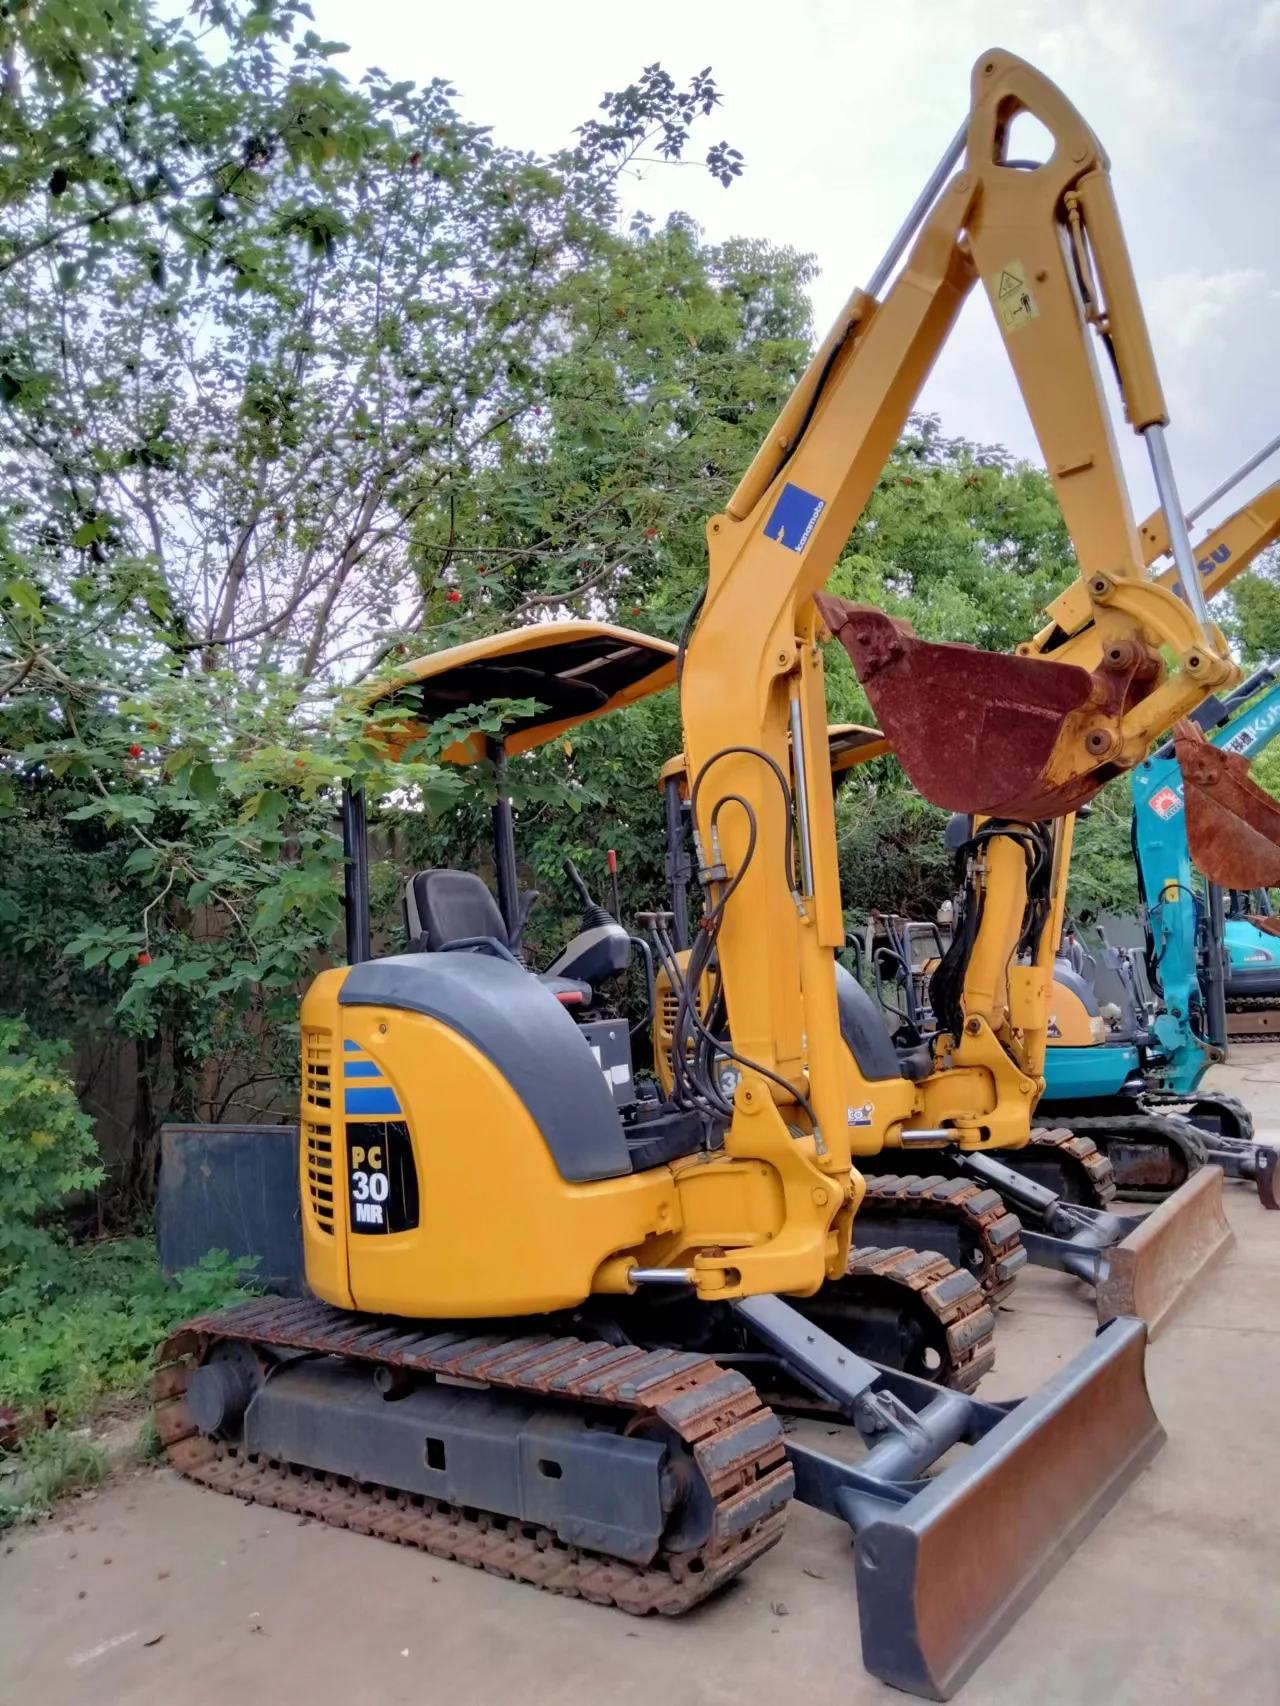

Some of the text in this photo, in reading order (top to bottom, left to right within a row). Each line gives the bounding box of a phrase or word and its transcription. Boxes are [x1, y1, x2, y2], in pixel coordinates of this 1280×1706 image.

[794, 500, 824, 552] kanamoto
[352, 1146, 382, 1169] PC
[352, 1171, 389, 1202] 30
[356, 1203, 384, 1224] MR
